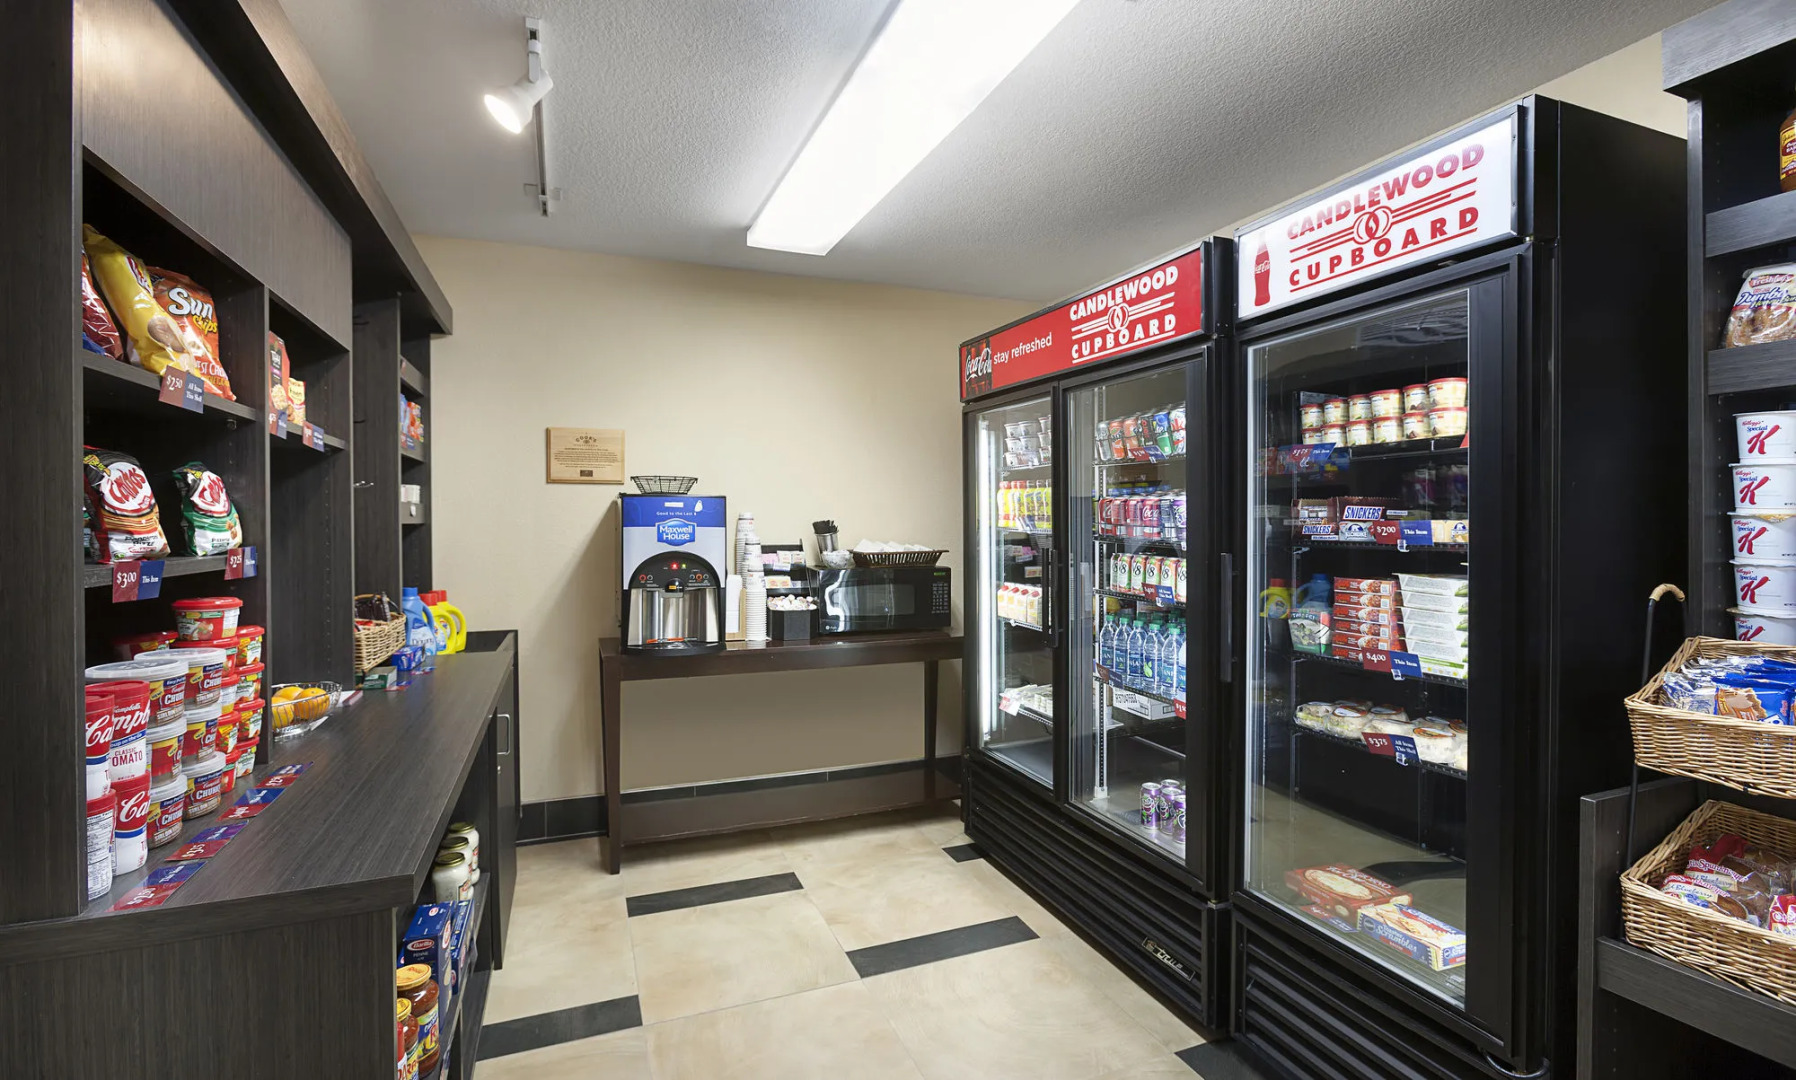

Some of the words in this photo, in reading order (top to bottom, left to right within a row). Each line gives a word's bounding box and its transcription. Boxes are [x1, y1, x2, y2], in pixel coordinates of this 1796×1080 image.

[1287, 144, 1484, 239] CANDLEWOOD
[1289, 207, 1478, 286] CUPBOARD
[168, 287, 212, 320] Sun
[1070, 266, 1178, 320] CANDLEWOOD
[192, 315, 218, 335] Chips
[1072, 314, 1176, 359] CUPBOARD
[994, 349, 1009, 365] stay
[1011, 332, 1052, 360] refreshed
[1747, 424, 1780, 454] K
[1740, 476, 1770, 505] K
[1345, 506, 1381, 519] SNICKERS
[1304, 525, 1331, 534] SNICKERS
[1377, 526, 1395, 535] $200
[1738, 527, 1767, 554] K
[116, 572, 137, 588] $300
[1133, 561, 1141, 575] V8
[1740, 576, 1769, 604] K
[1366, 652, 1386, 663] $400
[110, 750, 143, 767] OMATO
